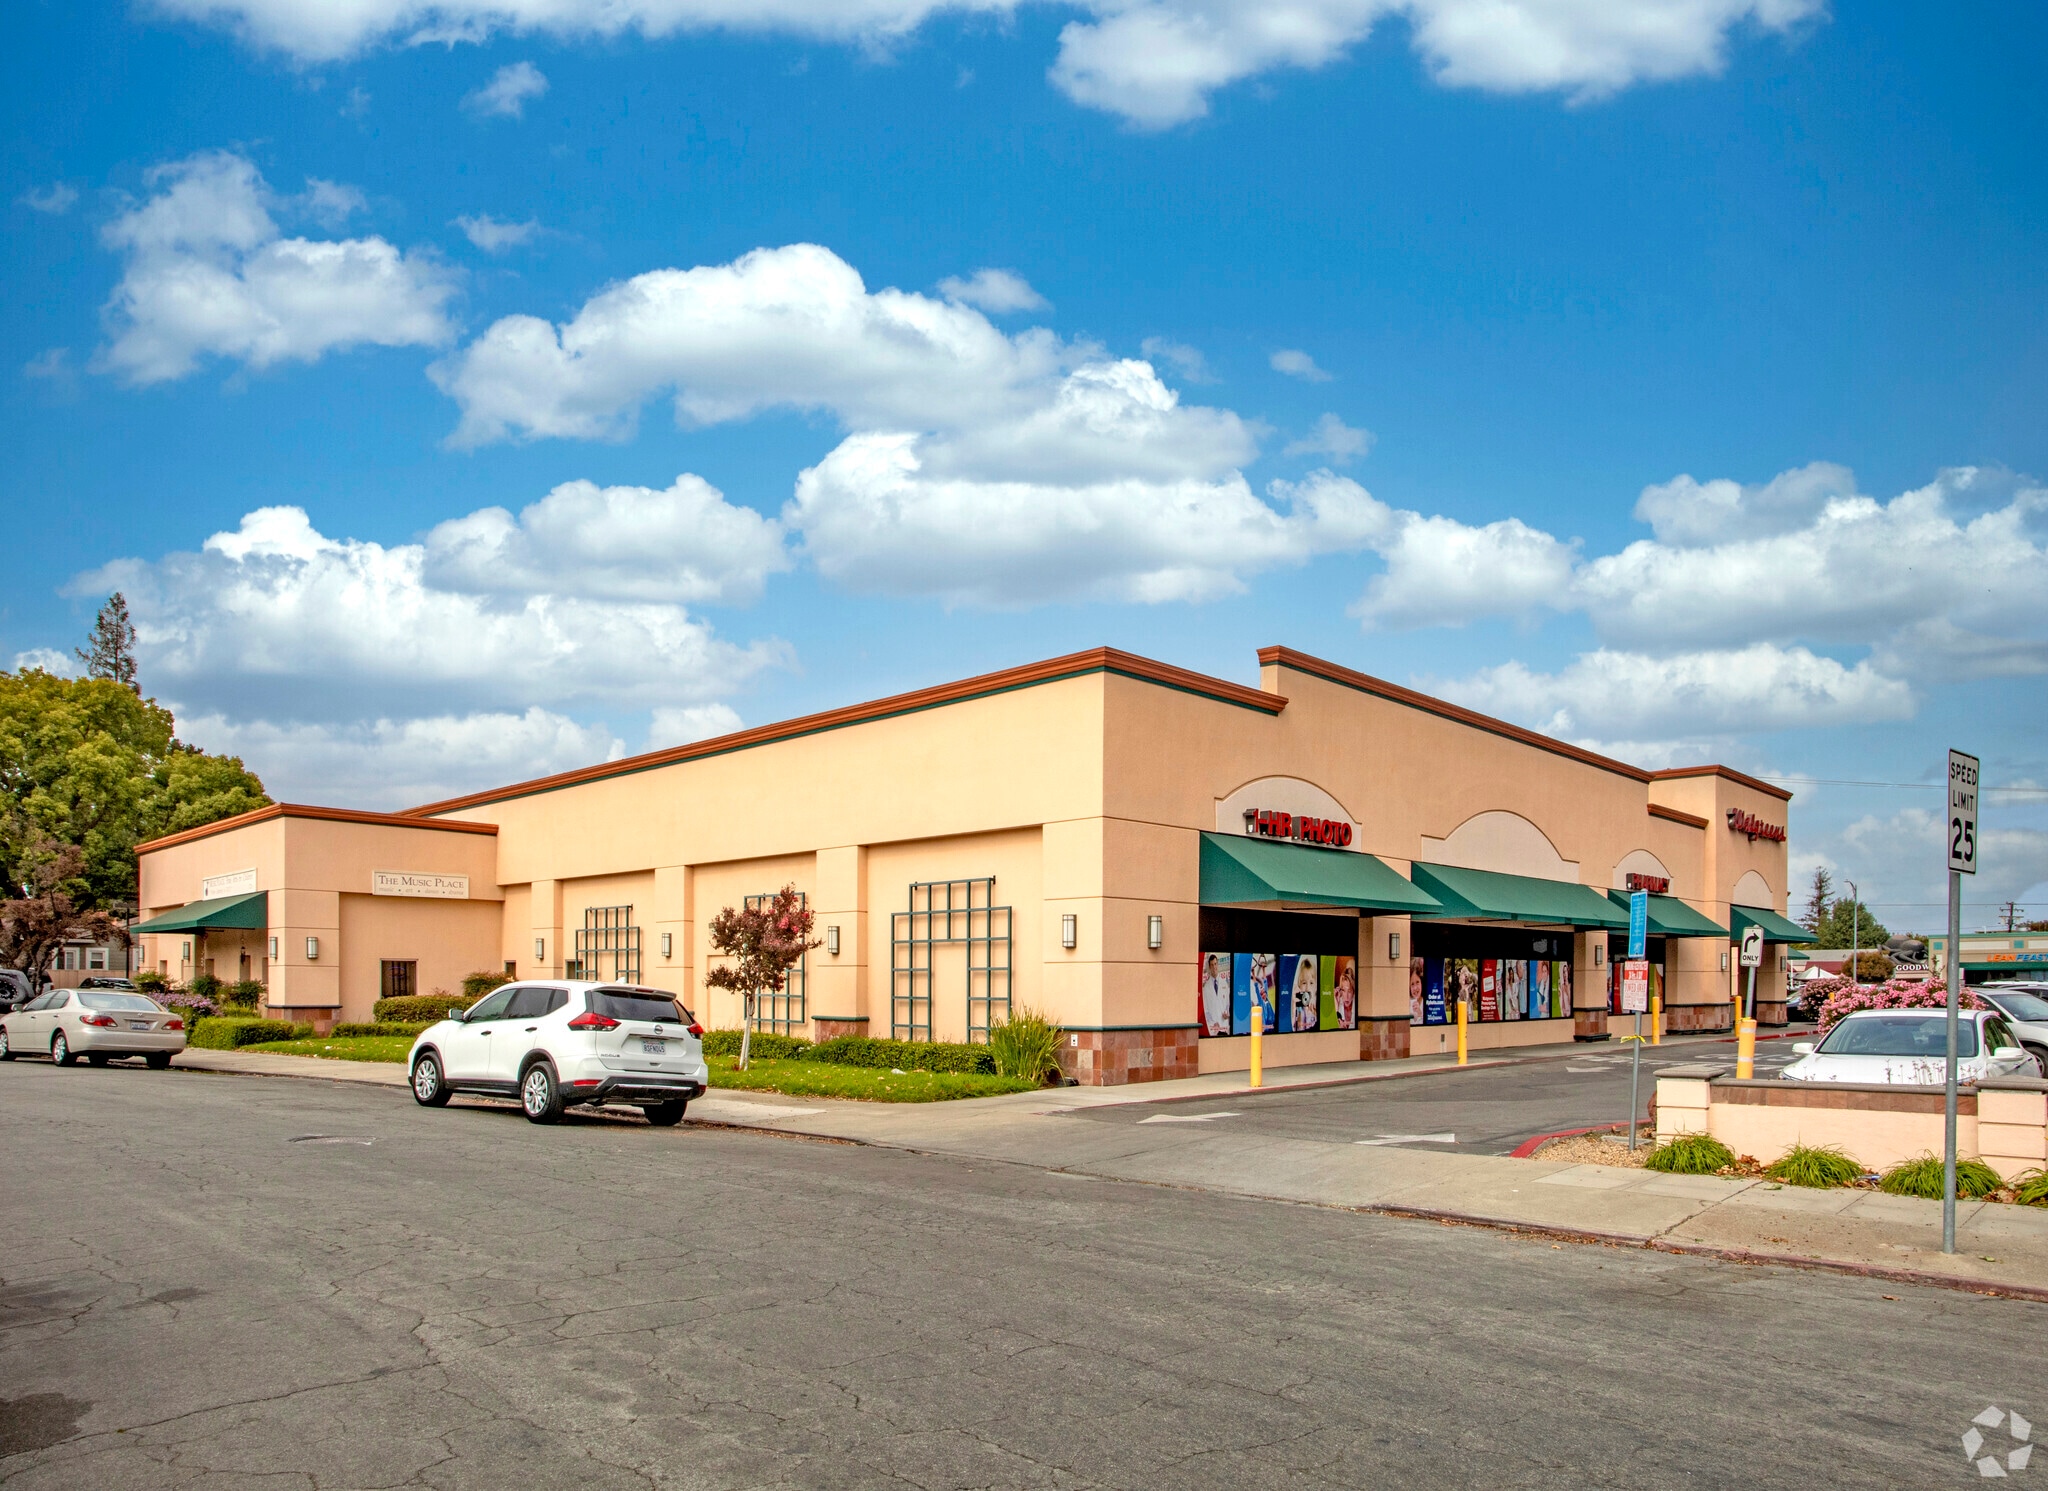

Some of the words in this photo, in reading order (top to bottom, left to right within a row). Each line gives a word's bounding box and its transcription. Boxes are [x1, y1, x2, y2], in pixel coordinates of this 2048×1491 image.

[1950, 762, 1977, 785] SPEED
[1952, 789, 1974, 811] LIMIT
[1248, 808, 1292, 837] 1-HR
[1300, 816, 1352, 846] PHOTO
[1730, 808, 1786, 842] Walgreens
[1951, 817, 1974, 862] 25
[378, 875, 399, 885] THE
[1631, 873, 1670, 893] PHARMACY
